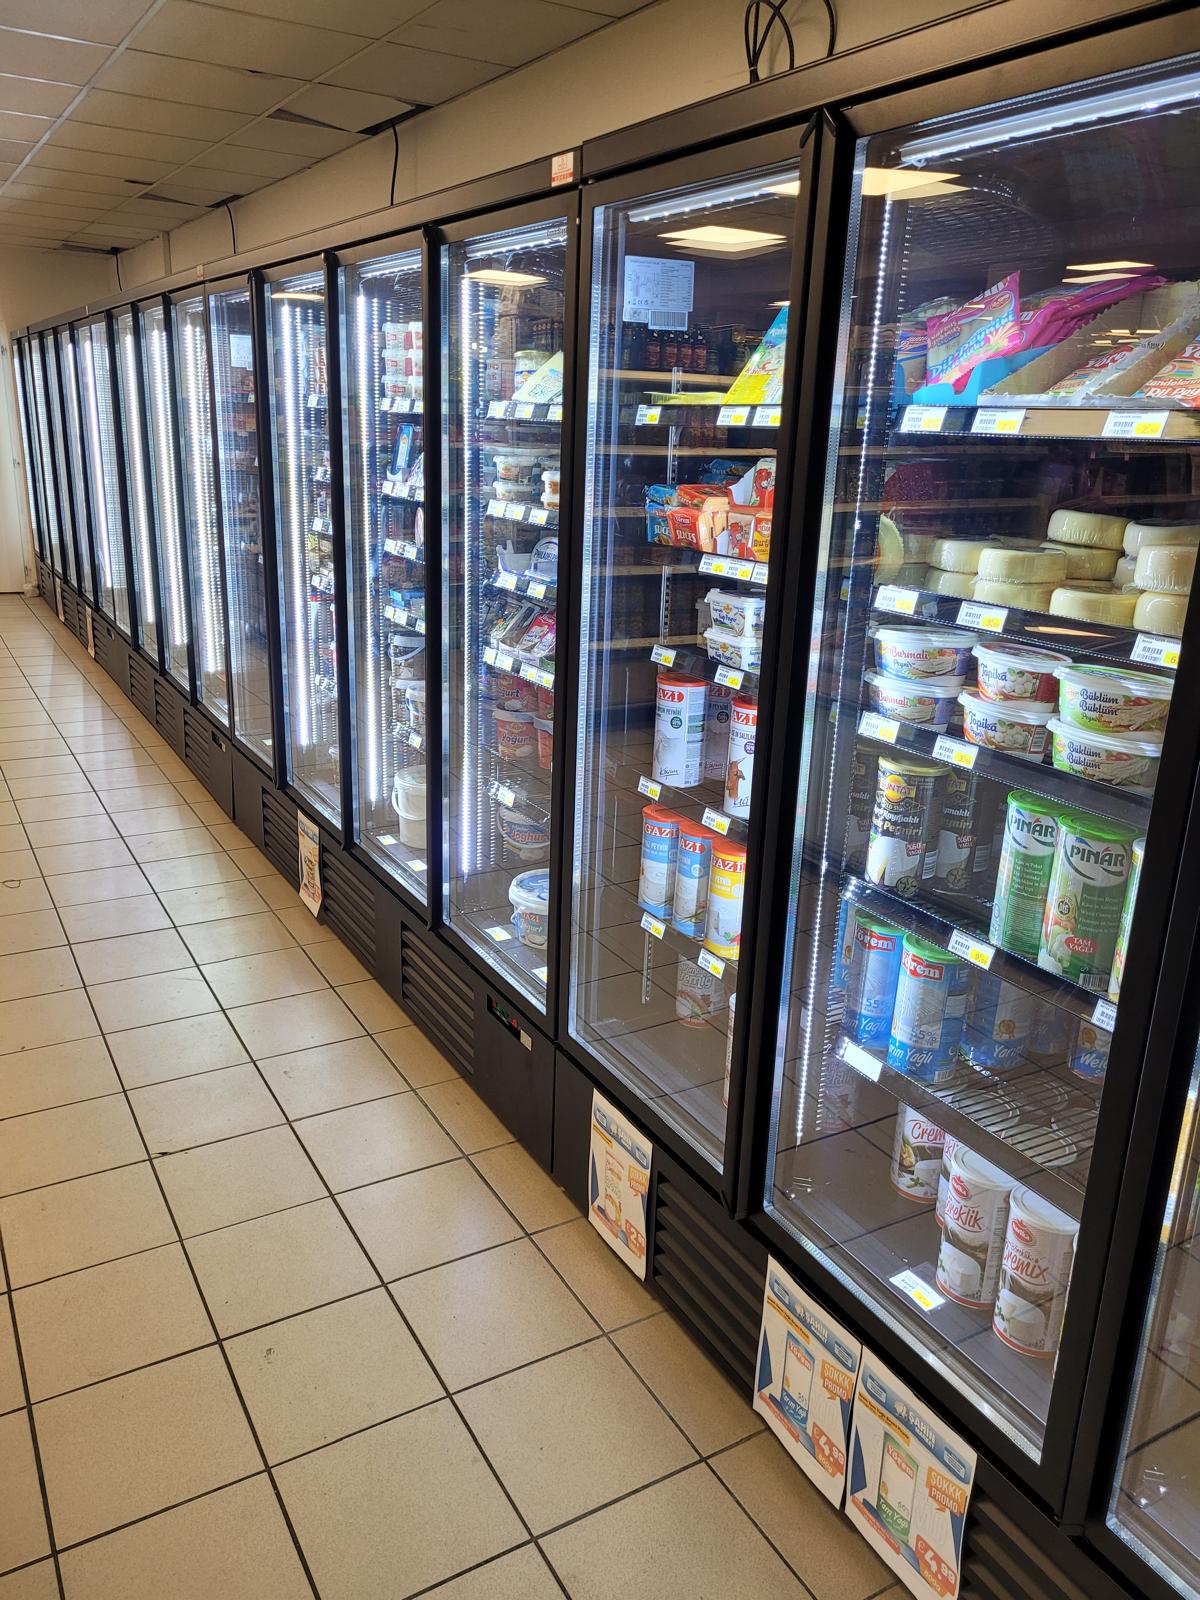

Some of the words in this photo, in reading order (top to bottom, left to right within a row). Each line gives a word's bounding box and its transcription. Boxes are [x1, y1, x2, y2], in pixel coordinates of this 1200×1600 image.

[1080, 688, 1120, 705] Büklüm
[1080, 699, 1119, 716] Büklüm
[969, 711, 998, 733] Topika
[1067, 741, 1102, 759] Büklüm
[1066, 752, 1102, 769] Büklüm
[1073, 938, 1092, 947] TAM
[906, 1048, 933, 1067] Yağlı
[824, 1378, 847, 1401] PROMO
[931, 1487, 959, 1513] PROMO
